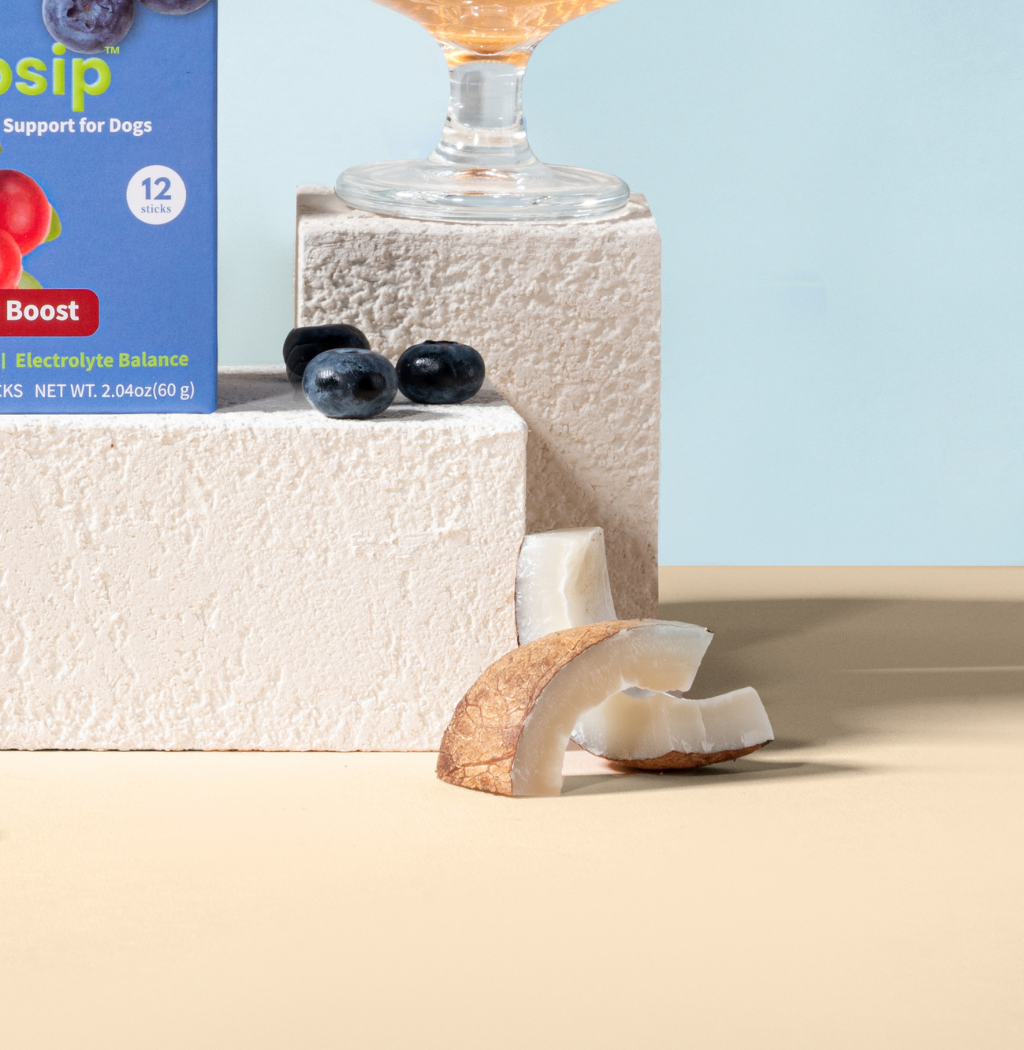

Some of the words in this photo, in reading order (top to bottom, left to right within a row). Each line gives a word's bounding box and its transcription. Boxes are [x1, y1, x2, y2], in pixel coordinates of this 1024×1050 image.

[3, 118, 76, 136] Support
[79, 117, 105, 133] for
[109, 118, 153, 137] Dogs
[141, 177, 172, 201] 12
[140, 203, 172, 214] sticks
[6, 300, 80, 322] Boost
[16, 352, 114, 372] Electrolyte
[119, 351, 189, 368] Balance
[35, 383, 66, 398] NET
[70, 383, 97, 398] WT.
